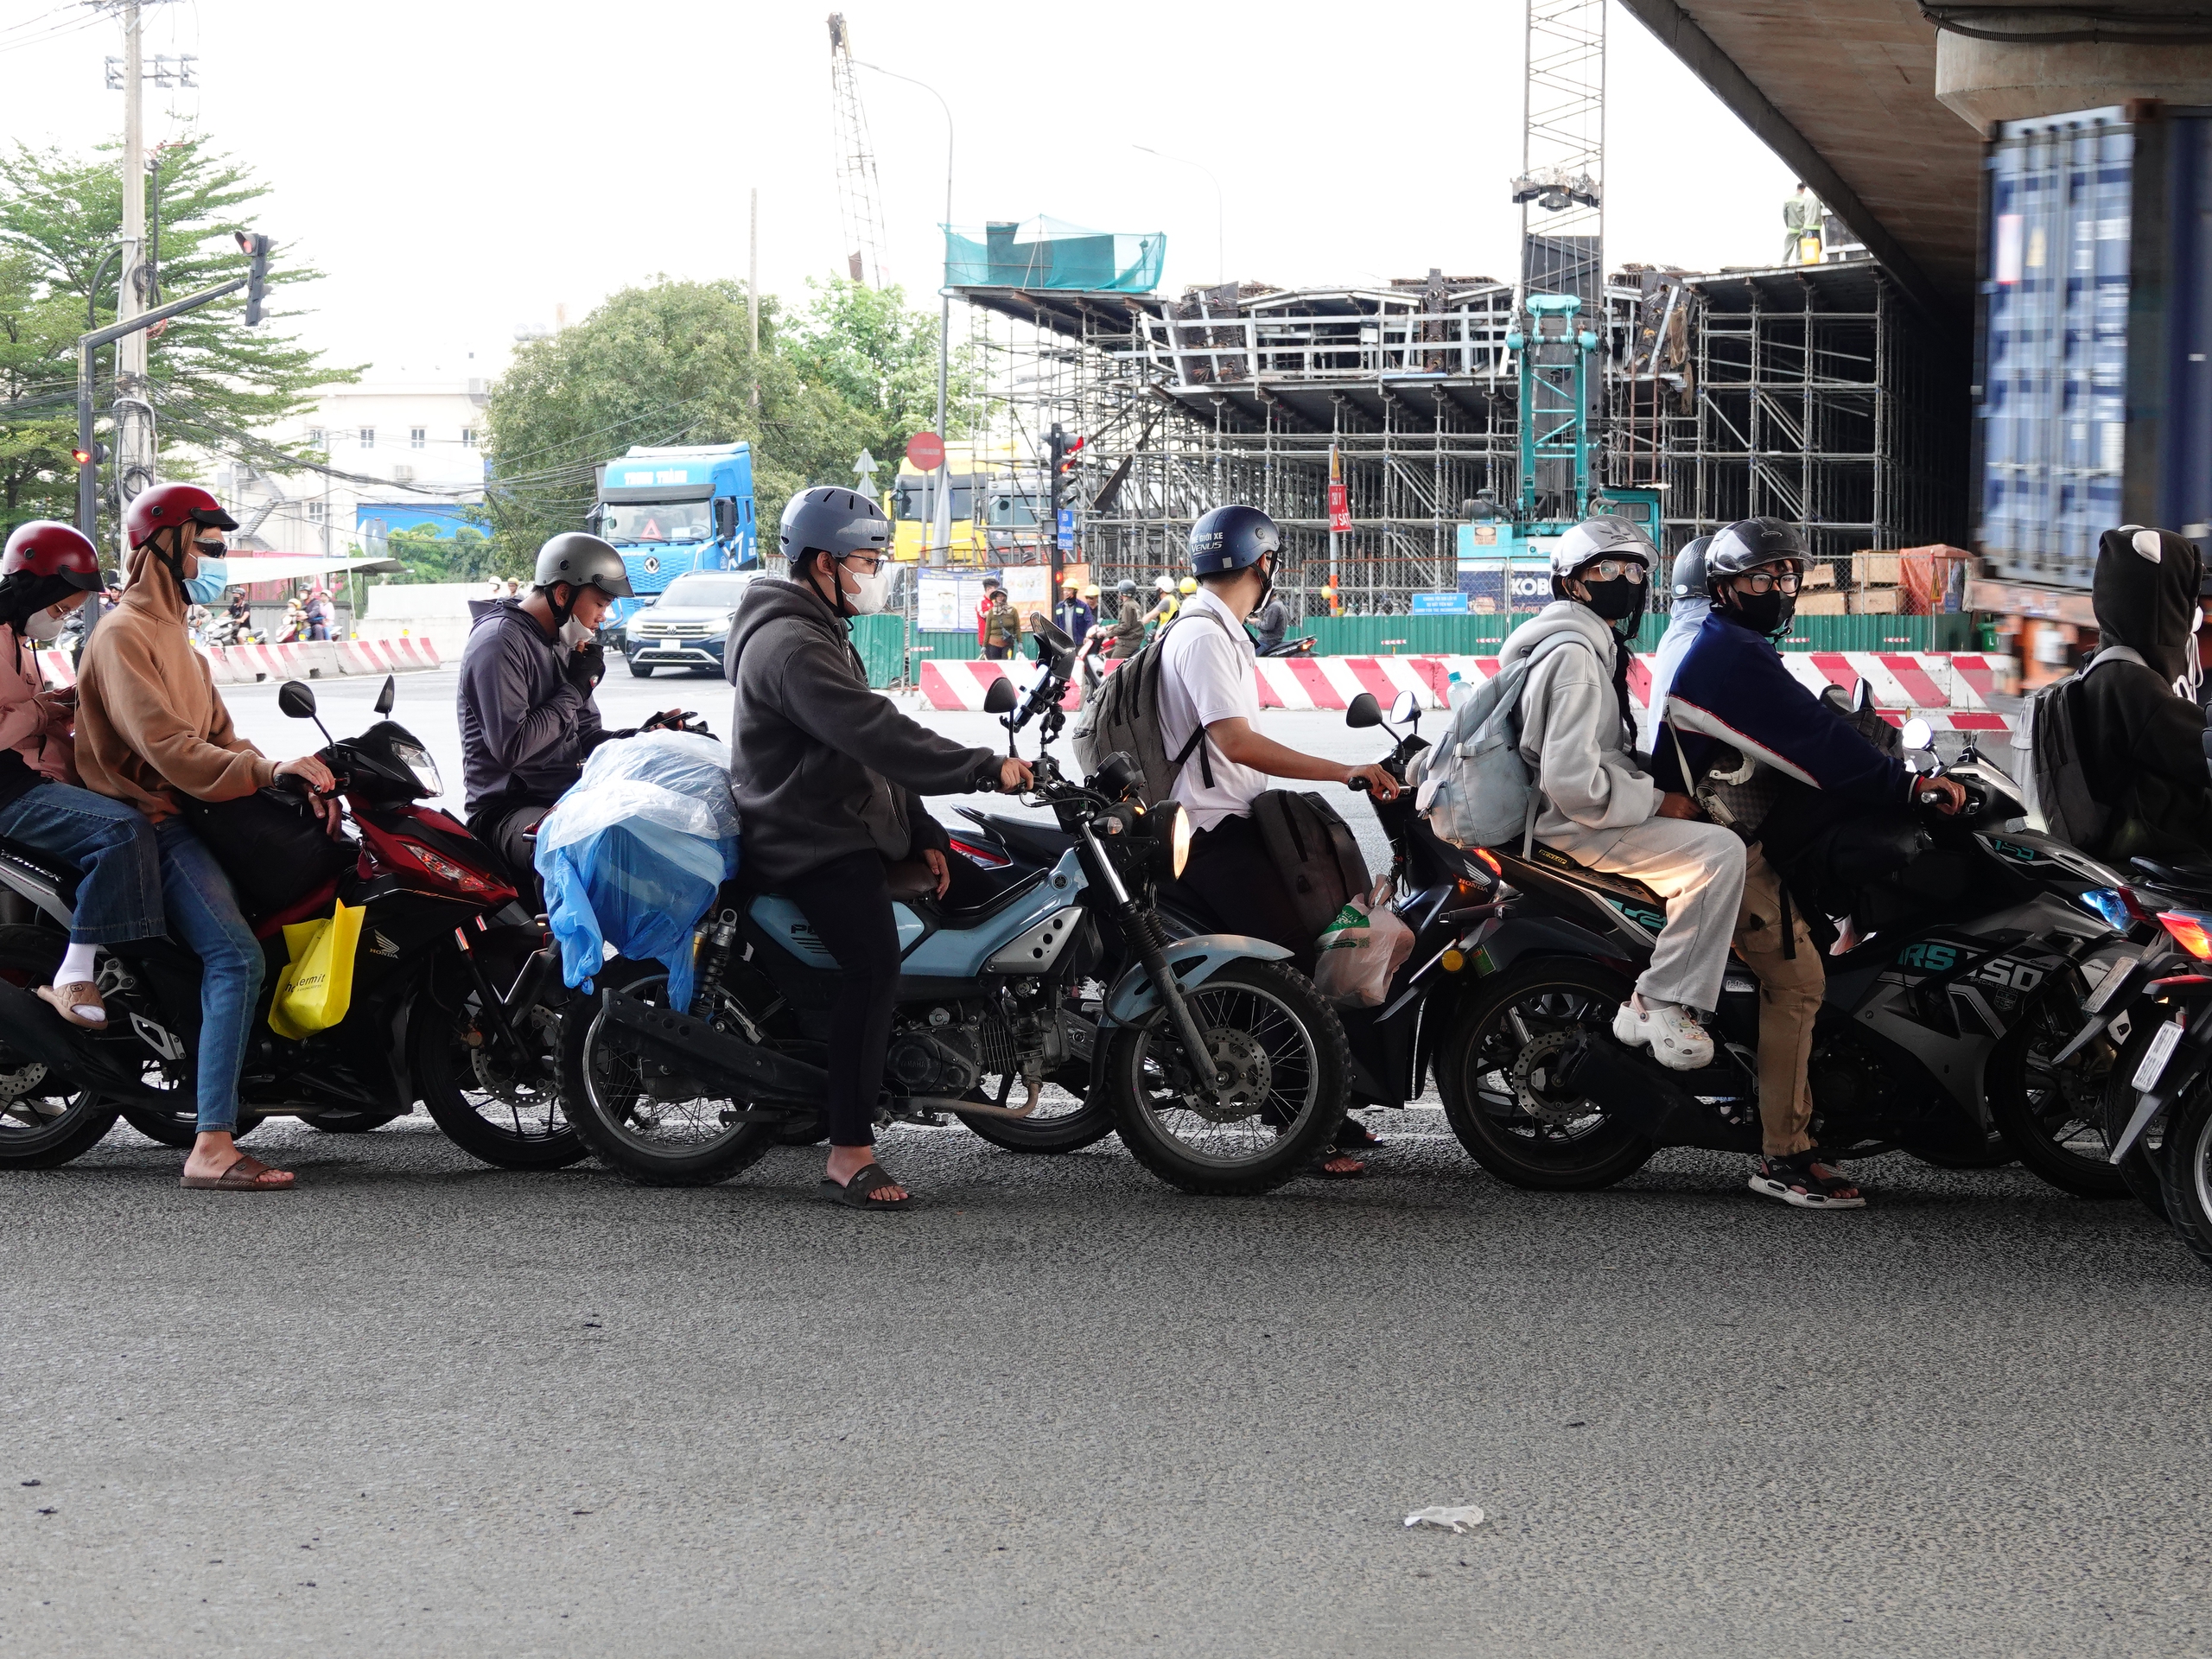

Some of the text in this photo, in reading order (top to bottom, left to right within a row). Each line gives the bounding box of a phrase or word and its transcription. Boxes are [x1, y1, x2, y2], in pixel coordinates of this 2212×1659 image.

[1192, 541, 1224, 553] VENUS
[1510, 577, 1550, 596] KOB
[1539, 849, 1567, 865] DUNLOP
[1458, 877, 1489, 893] HONDA
[369, 948, 400, 960] HONDA
[1897, 943, 1957, 971] RS
[1969, 976, 2020, 995] SPECIAL EDITION
